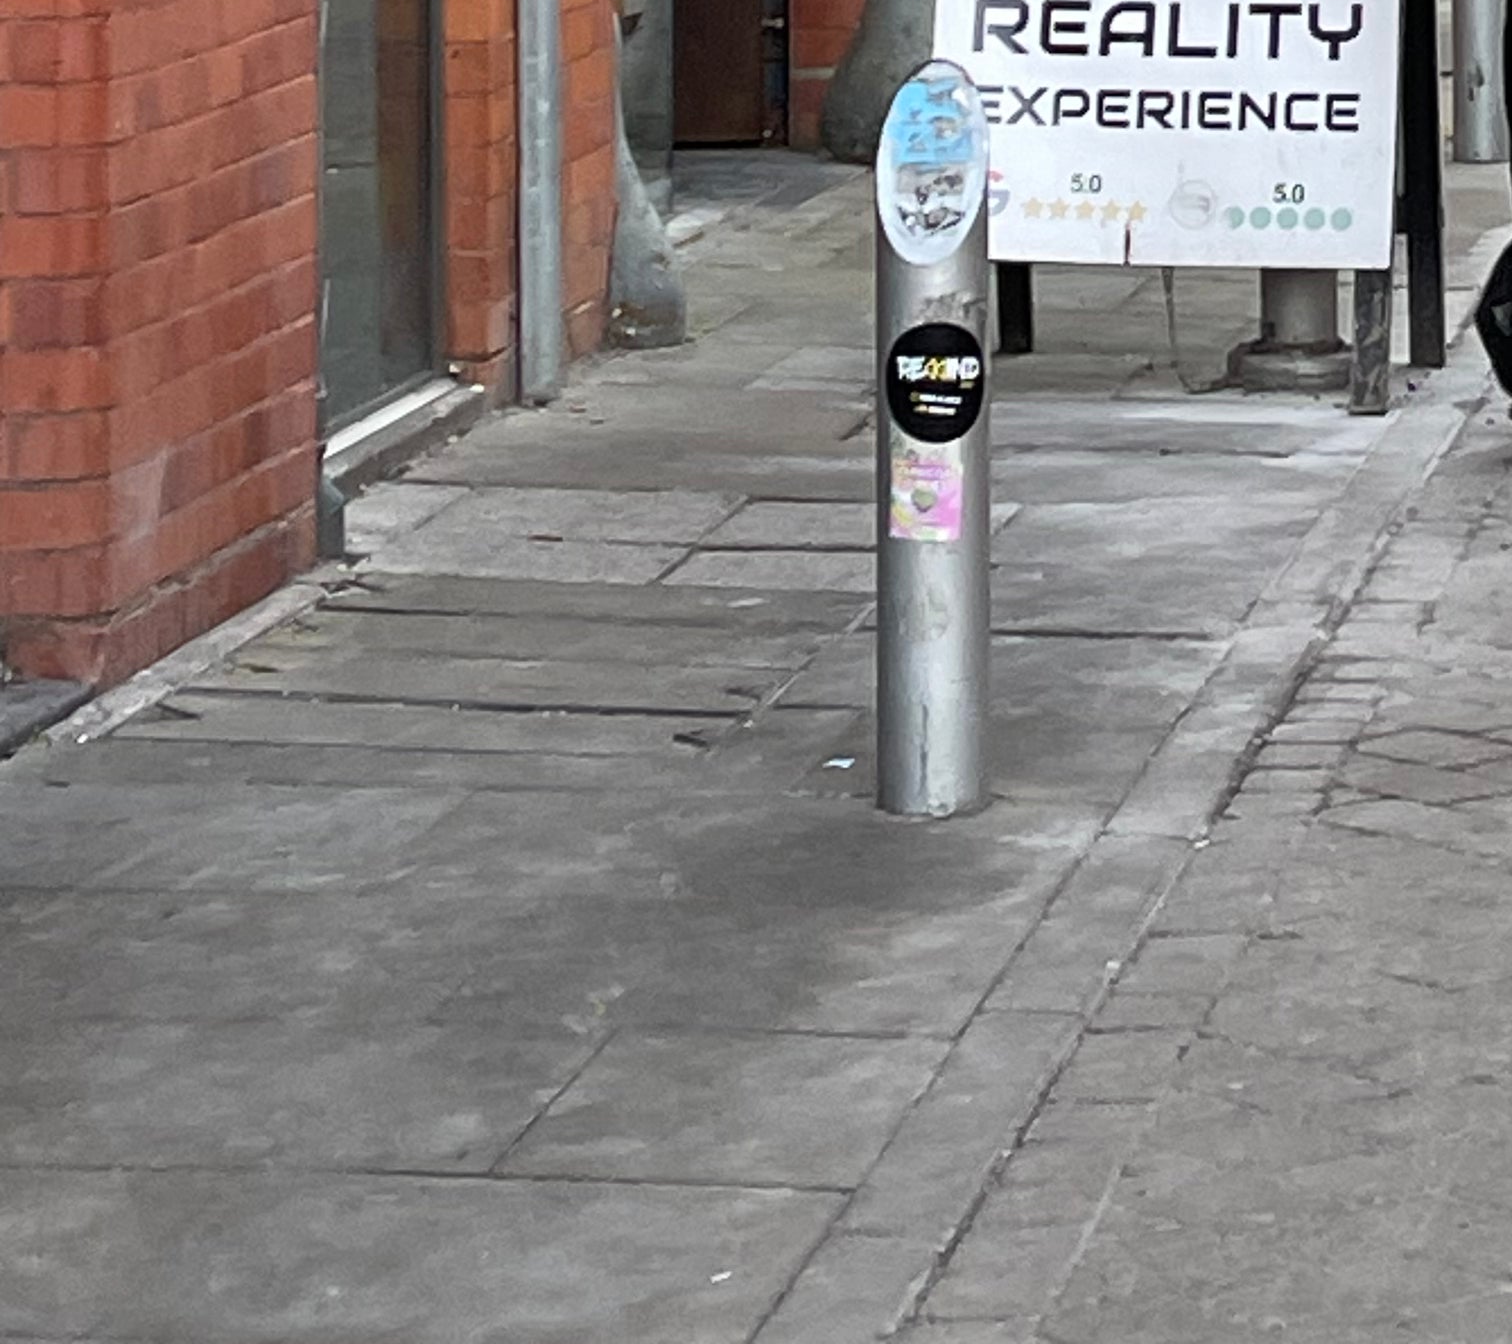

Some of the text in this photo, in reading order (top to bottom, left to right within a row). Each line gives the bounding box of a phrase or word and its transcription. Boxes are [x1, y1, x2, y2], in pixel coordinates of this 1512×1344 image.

[975, 85, 1361, 133] EXPERIENCE
[1070, 173, 1103, 195] 5.0
[1272, 182, 1306, 205] 5.0
